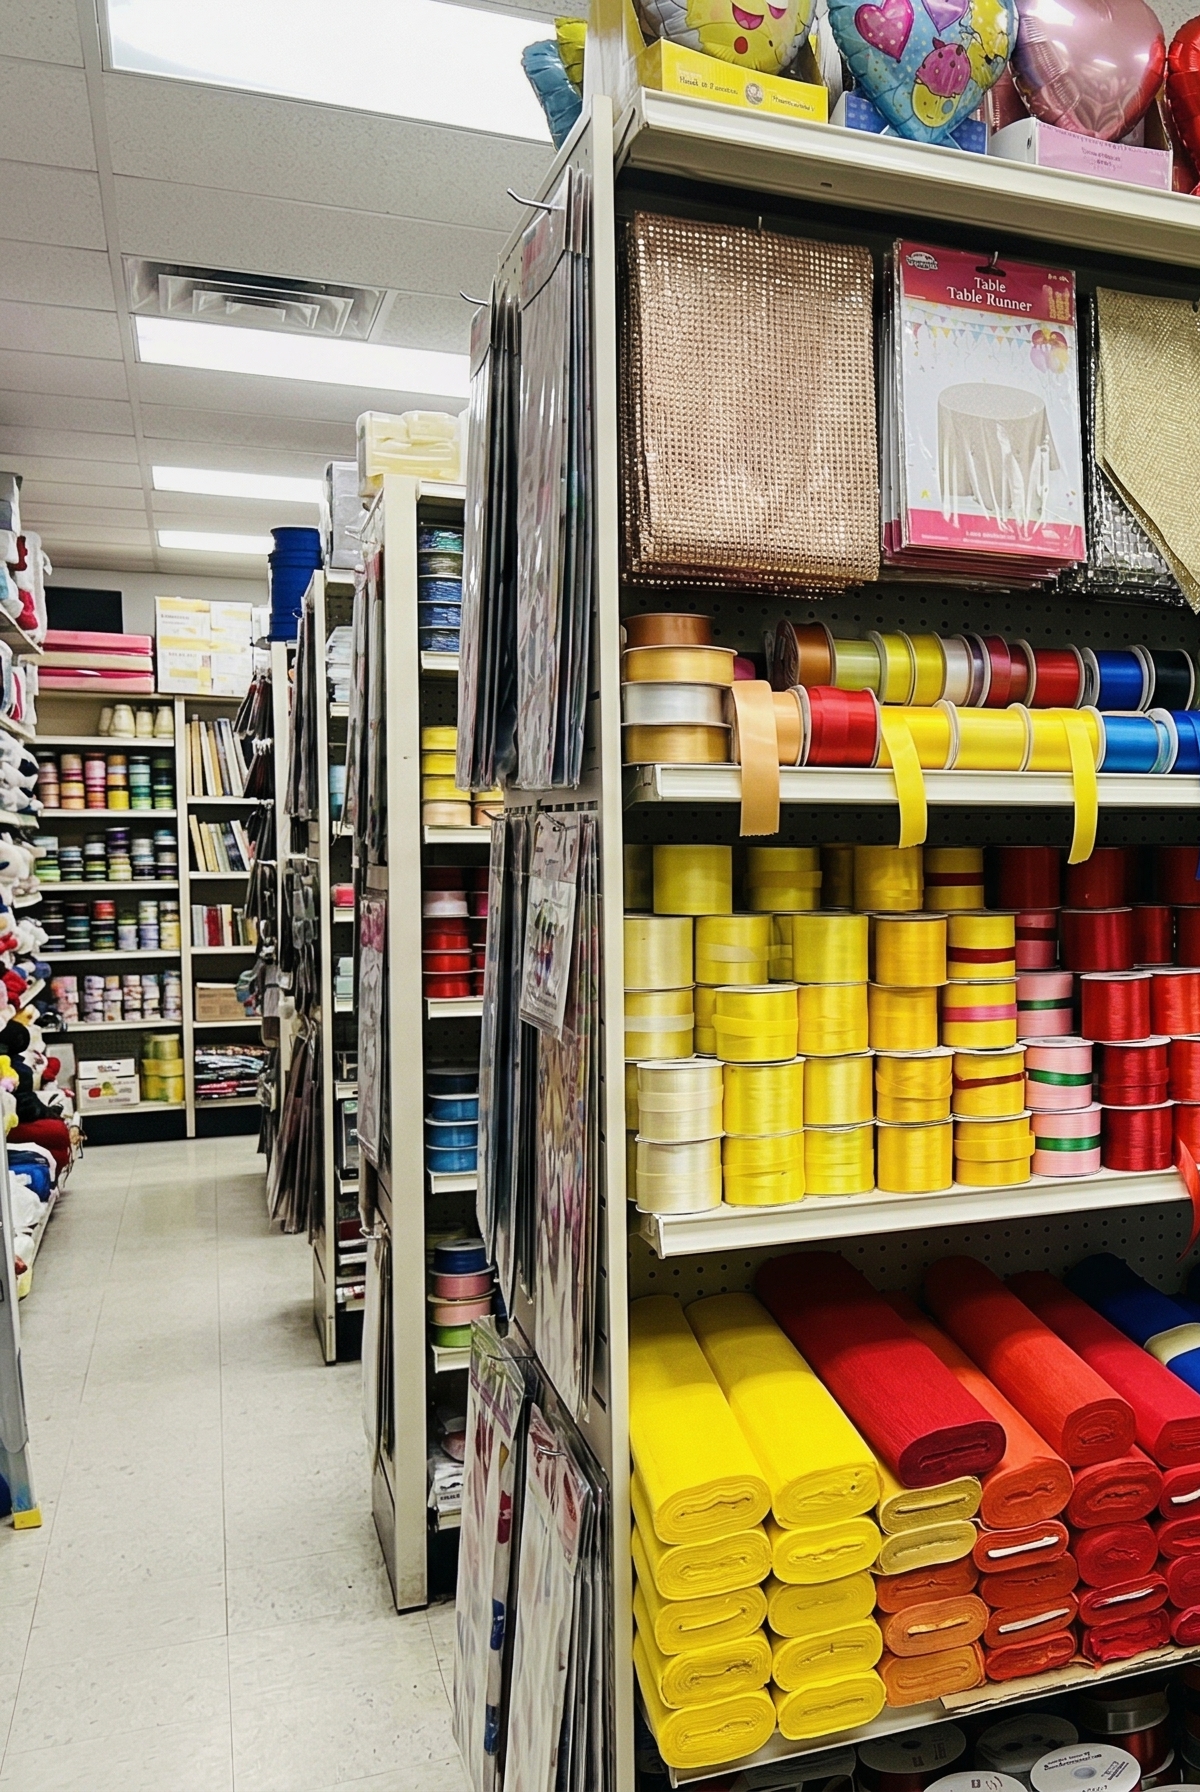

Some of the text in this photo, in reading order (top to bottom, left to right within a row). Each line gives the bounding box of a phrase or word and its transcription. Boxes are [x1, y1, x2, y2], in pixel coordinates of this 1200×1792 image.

[974, 277, 1006, 293] Table
[947, 286, 1032, 312] Table Runner
